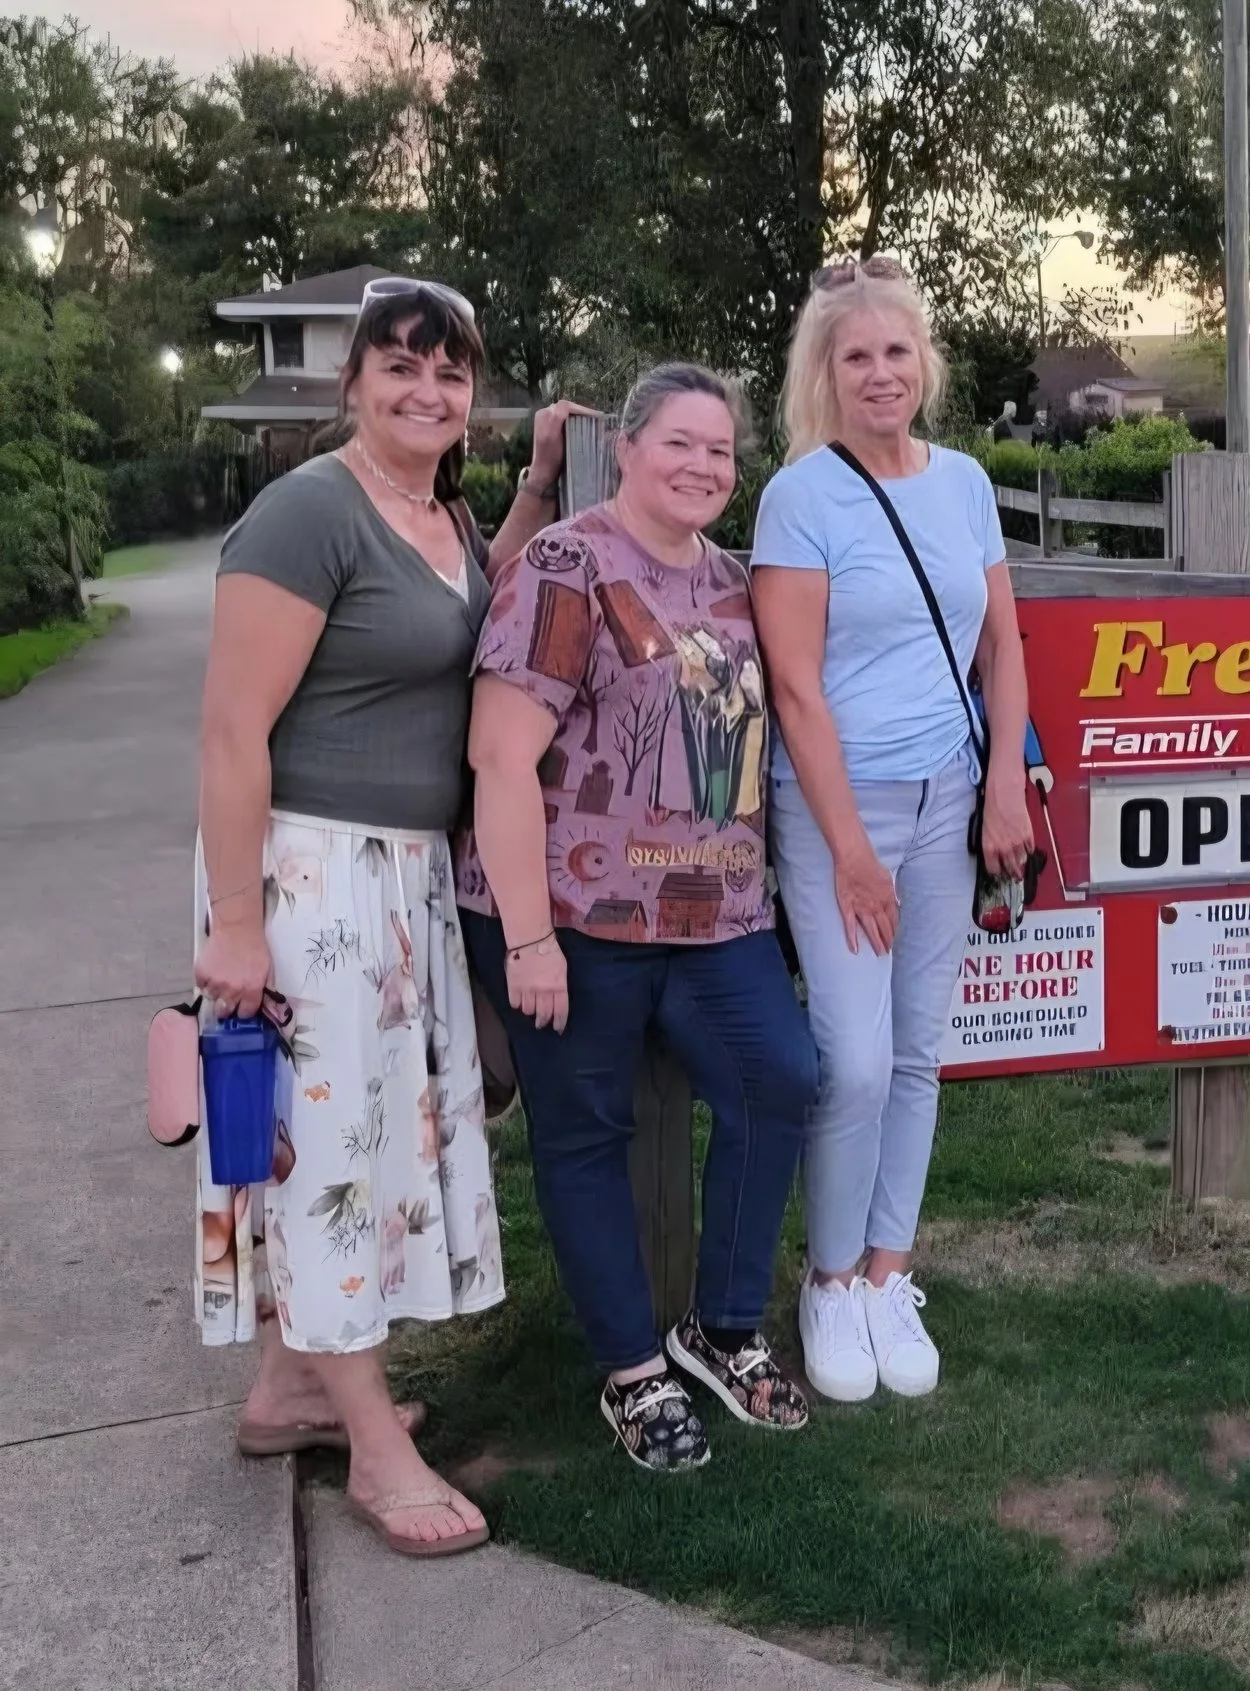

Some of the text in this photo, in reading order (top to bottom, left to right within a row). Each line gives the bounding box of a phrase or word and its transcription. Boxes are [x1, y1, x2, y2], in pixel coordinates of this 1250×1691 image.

[1082, 722, 1239, 756] Family
[958, 950, 1094, 978] NE HOUR
[964, 976, 1078, 1004] BEFORE
[962, 1023, 1077, 1045] CLOSING TIME
